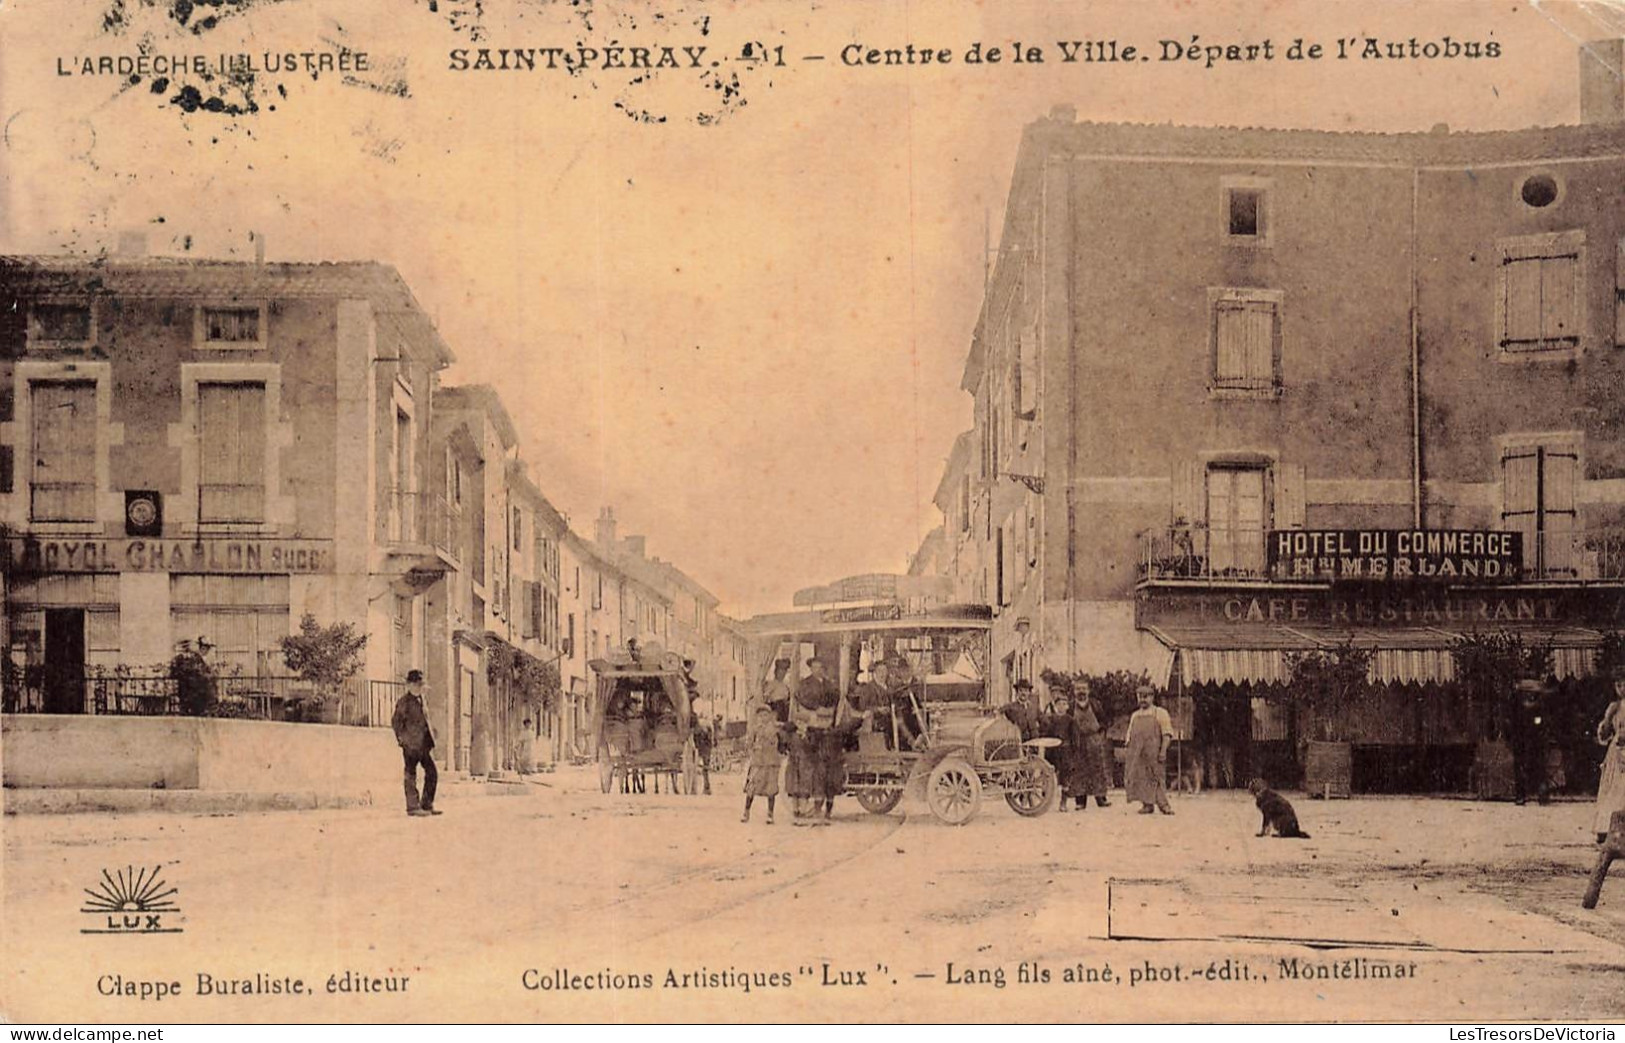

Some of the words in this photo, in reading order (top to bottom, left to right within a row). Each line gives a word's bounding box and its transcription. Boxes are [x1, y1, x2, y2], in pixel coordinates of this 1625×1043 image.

[840, 42, 953, 65] Centre
[965, 42, 1001, 64] de
[1012, 42, 1045, 63] la
[1056, 40, 1151, 63] Ville.
[1158, 35, 1275, 68] Départ
[1285, 38, 1324, 61] de
[1278, 532, 1352, 555] HOTEL
[1359, 532, 1389, 553] DU
[1397, 532, 1514, 556] COMMERCE
[1341, 556, 1501, 577] MERLAND
[107, 914, 162, 930] LUX
[196, 973, 314, 996] Buraliste,
[326, 971, 411, 995] éditeur
[521, 968, 653, 991] Collections
[663, 966, 793, 993] Artistiques
[945, 963, 1006, 988] Lang
[1017, 963, 1051, 983] fils
[1278, 957, 1418, 981] Montélimar
